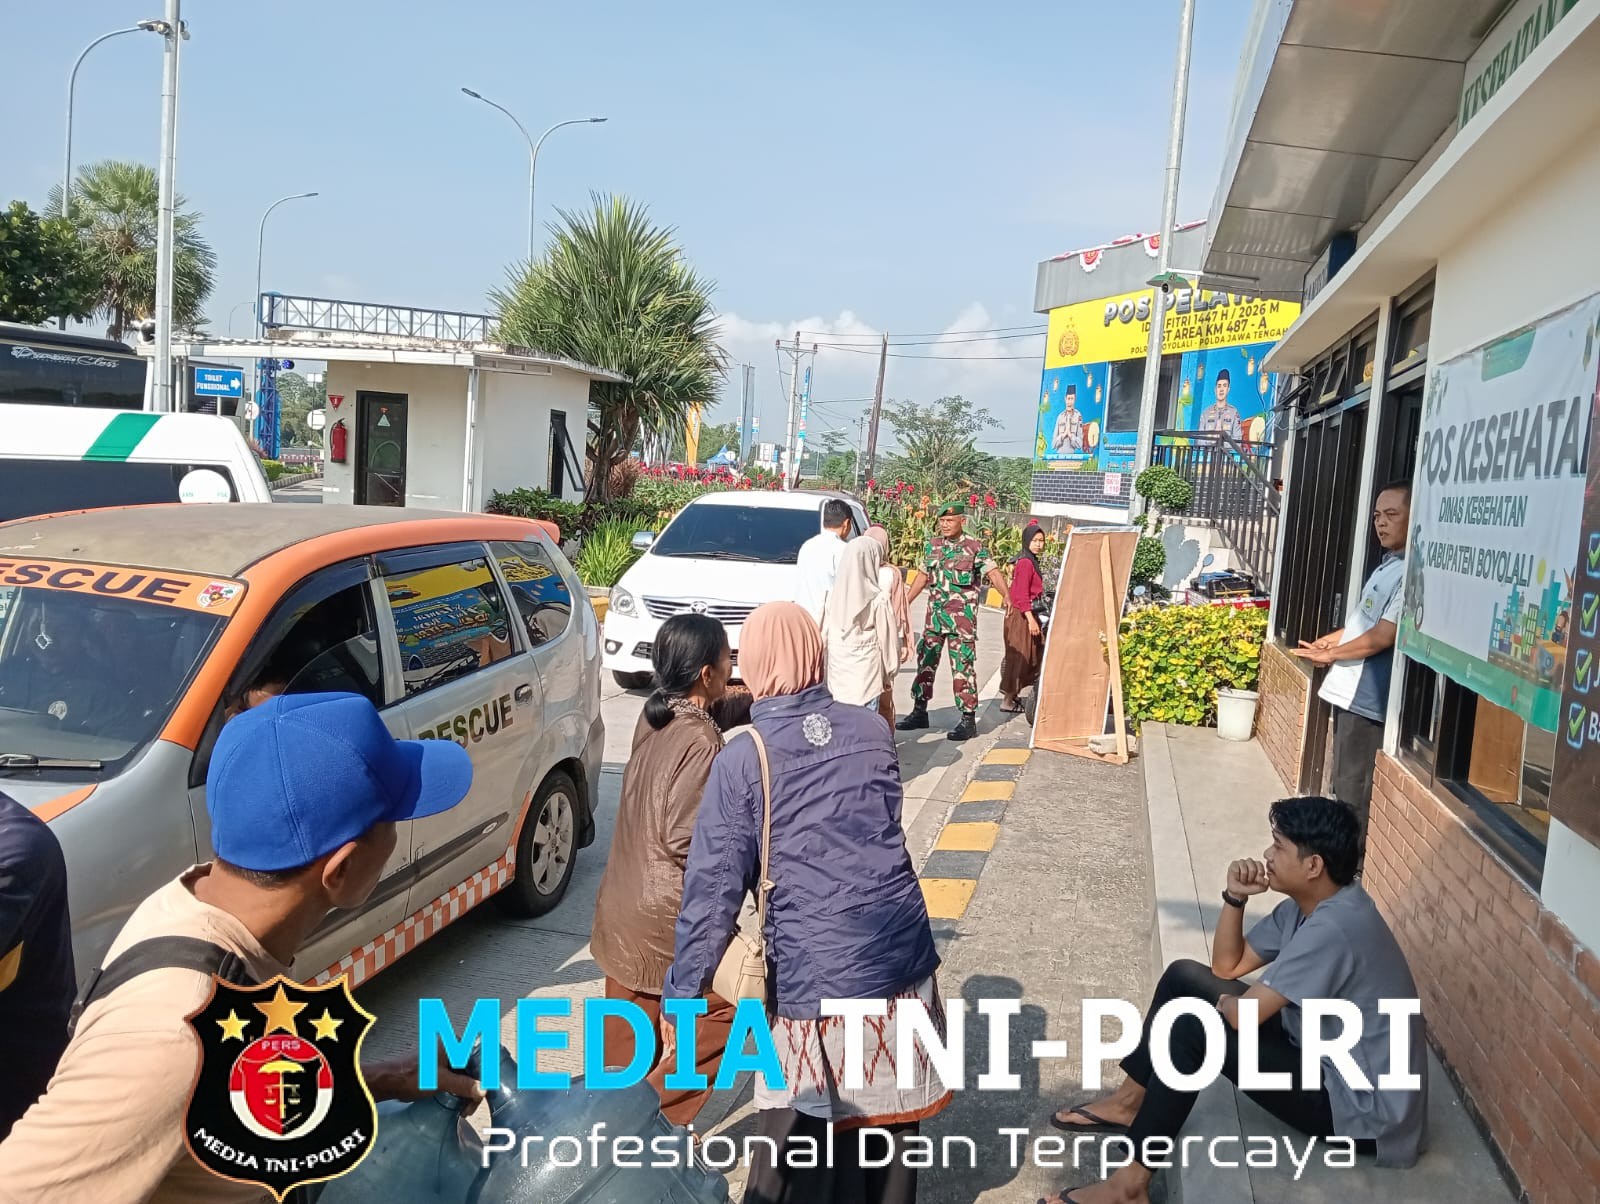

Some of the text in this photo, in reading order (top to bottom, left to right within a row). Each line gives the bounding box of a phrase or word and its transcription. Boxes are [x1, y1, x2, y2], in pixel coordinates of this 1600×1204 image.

[1104, 296, 1150, 327] POS
[1166, 315, 1192, 329] FITRI
[1194, 311, 1218, 325] 1447
[1221, 309, 1229, 321] H
[1231, 307, 1236, 320] /
[1239, 303, 1267, 318] 2026
[1269, 301, 1280, 314] M
[1161, 339, 1193, 351] OYOLALI
[1199, 335, 1225, 348] POLDA
[1227, 332, 1251, 343] JAWA
[1174, 325, 1203, 341] AREA
[1206, 322, 1224, 338] KM
[1226, 318, 1249, 333] 487
[1258, 316, 1267, 330] A
[204, 373, 223, 382] TOILET
[1421, 424, 1457, 487] POS
[1438, 495, 1528, 527] DINAS KESEHATAN
[1426, 541, 1534, 587] KABUPATEN BOYOLALI
